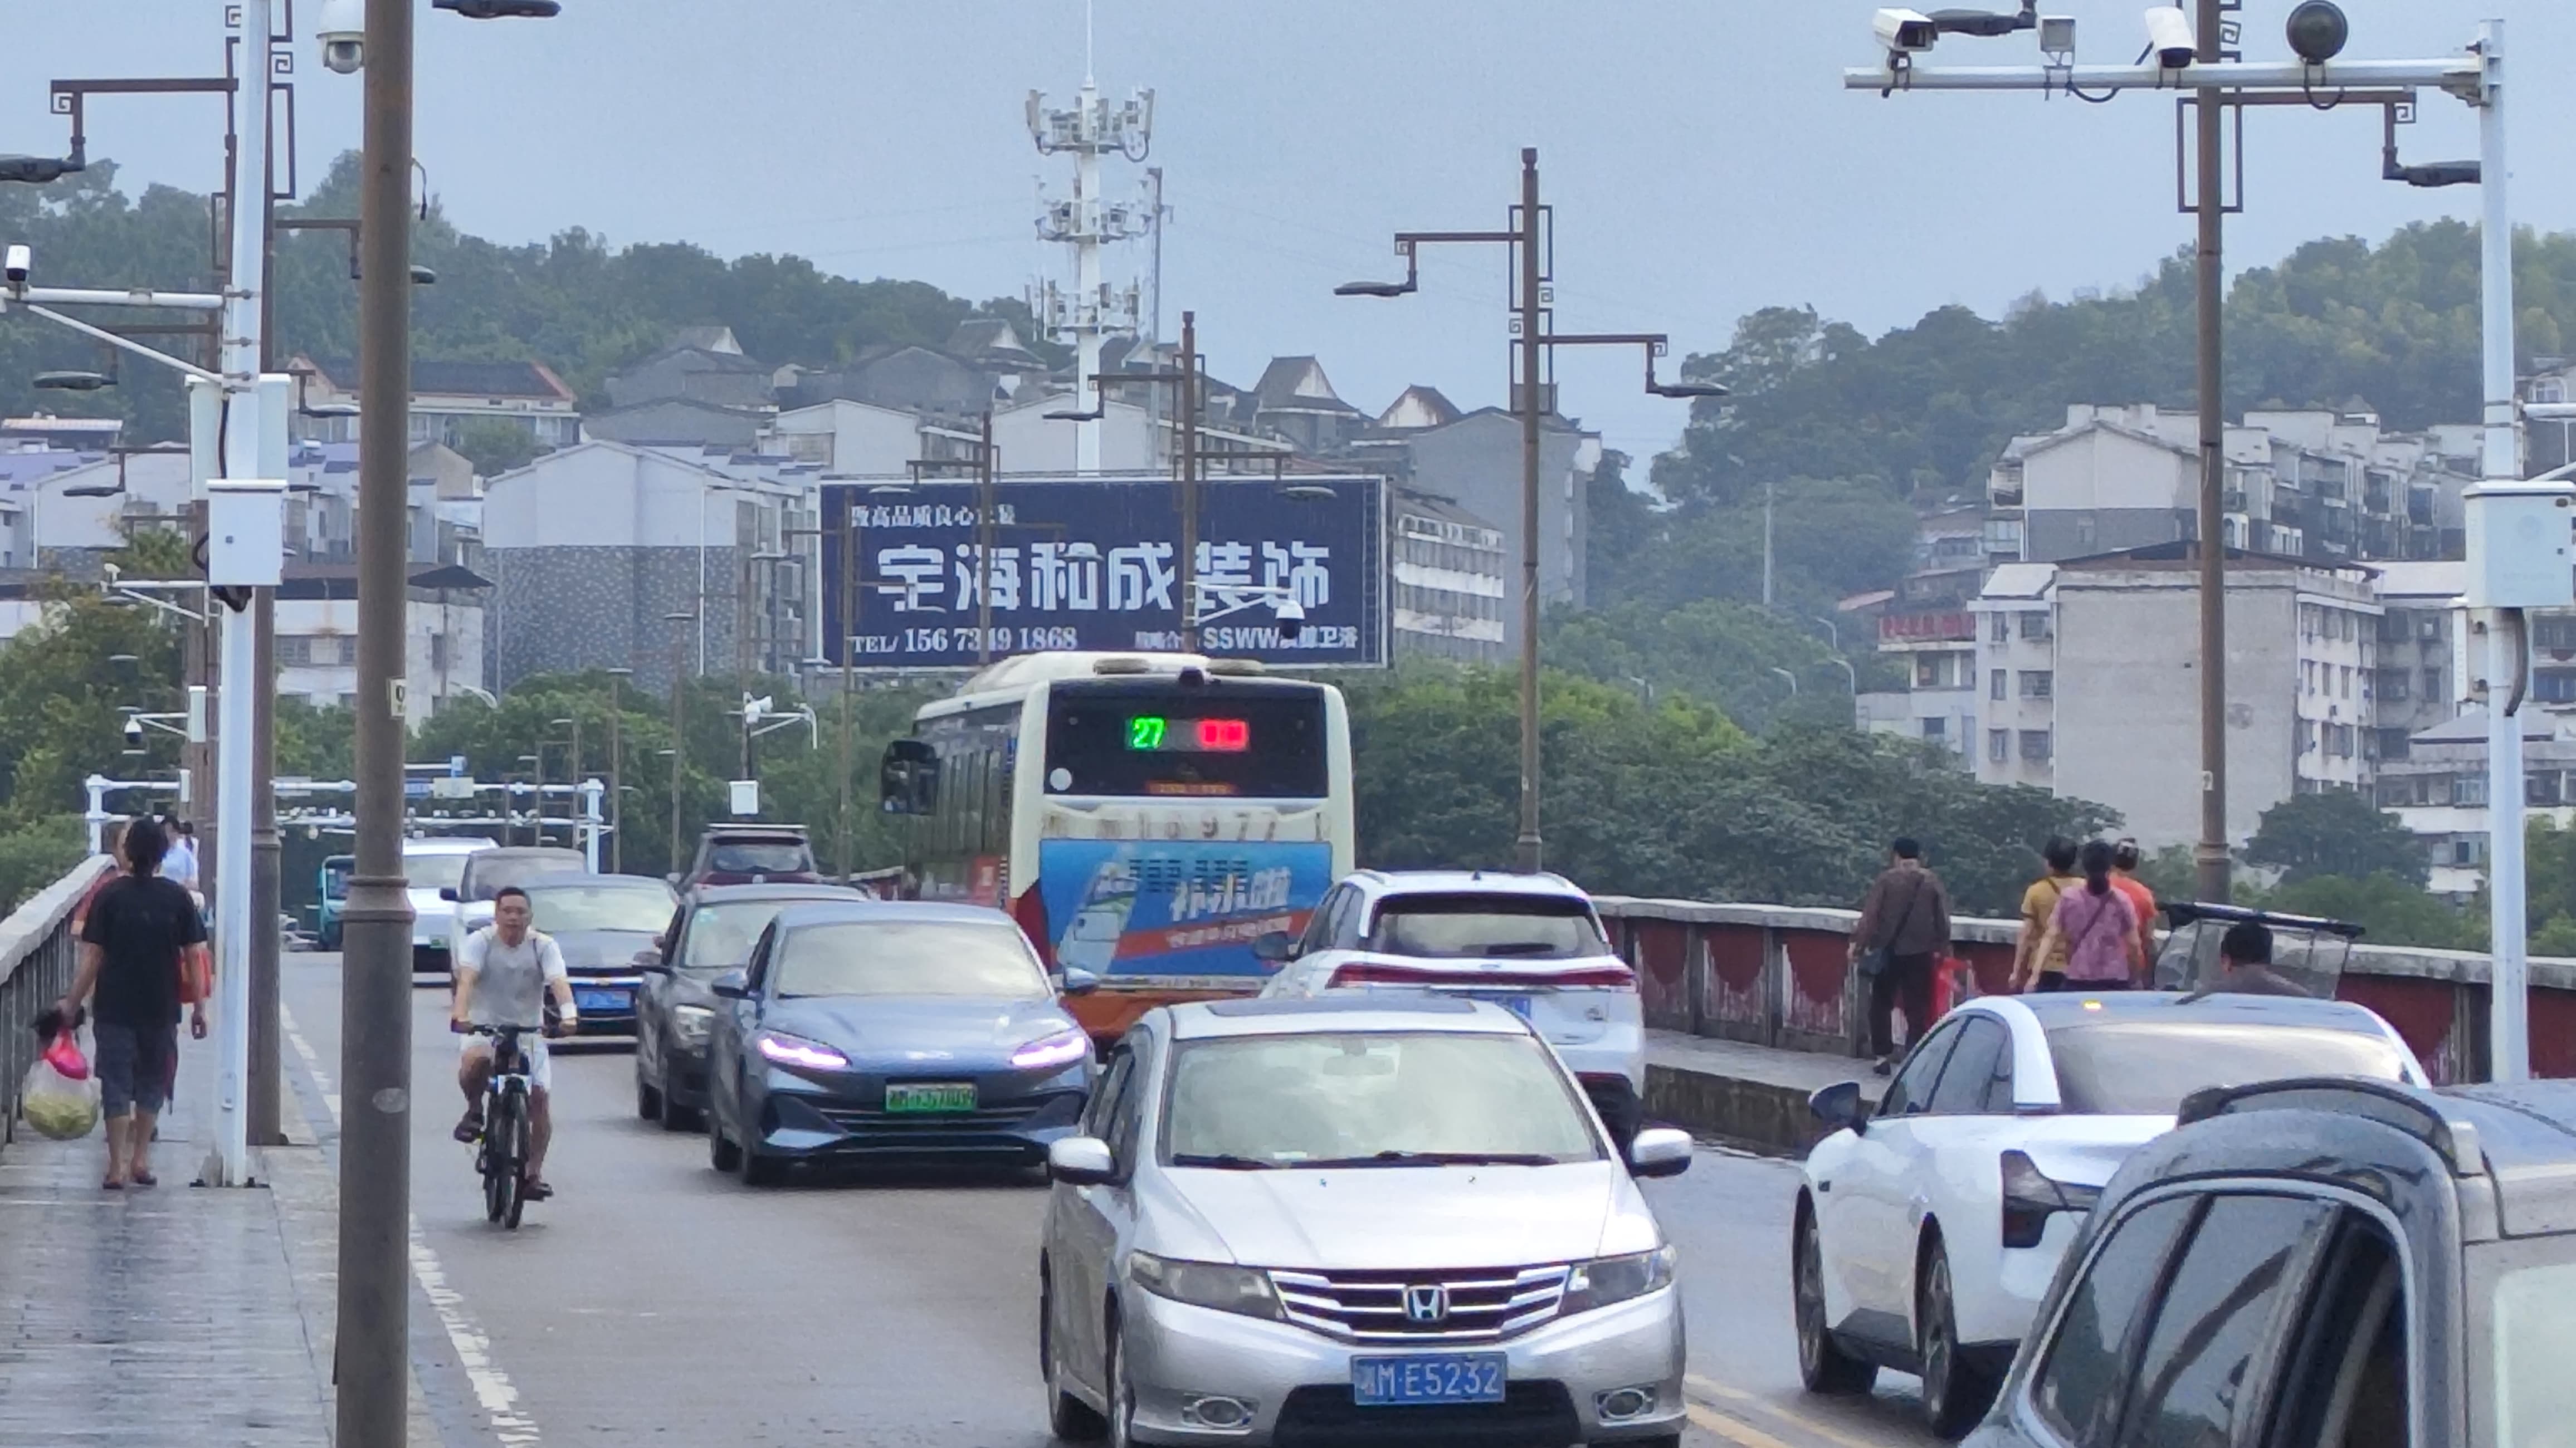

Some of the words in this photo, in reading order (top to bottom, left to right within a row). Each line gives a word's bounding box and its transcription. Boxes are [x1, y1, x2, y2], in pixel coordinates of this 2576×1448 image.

[905, 628, 948, 653] 156
[1019, 627, 1077, 651] 1868
[1133, 717, 1165, 749] 27
